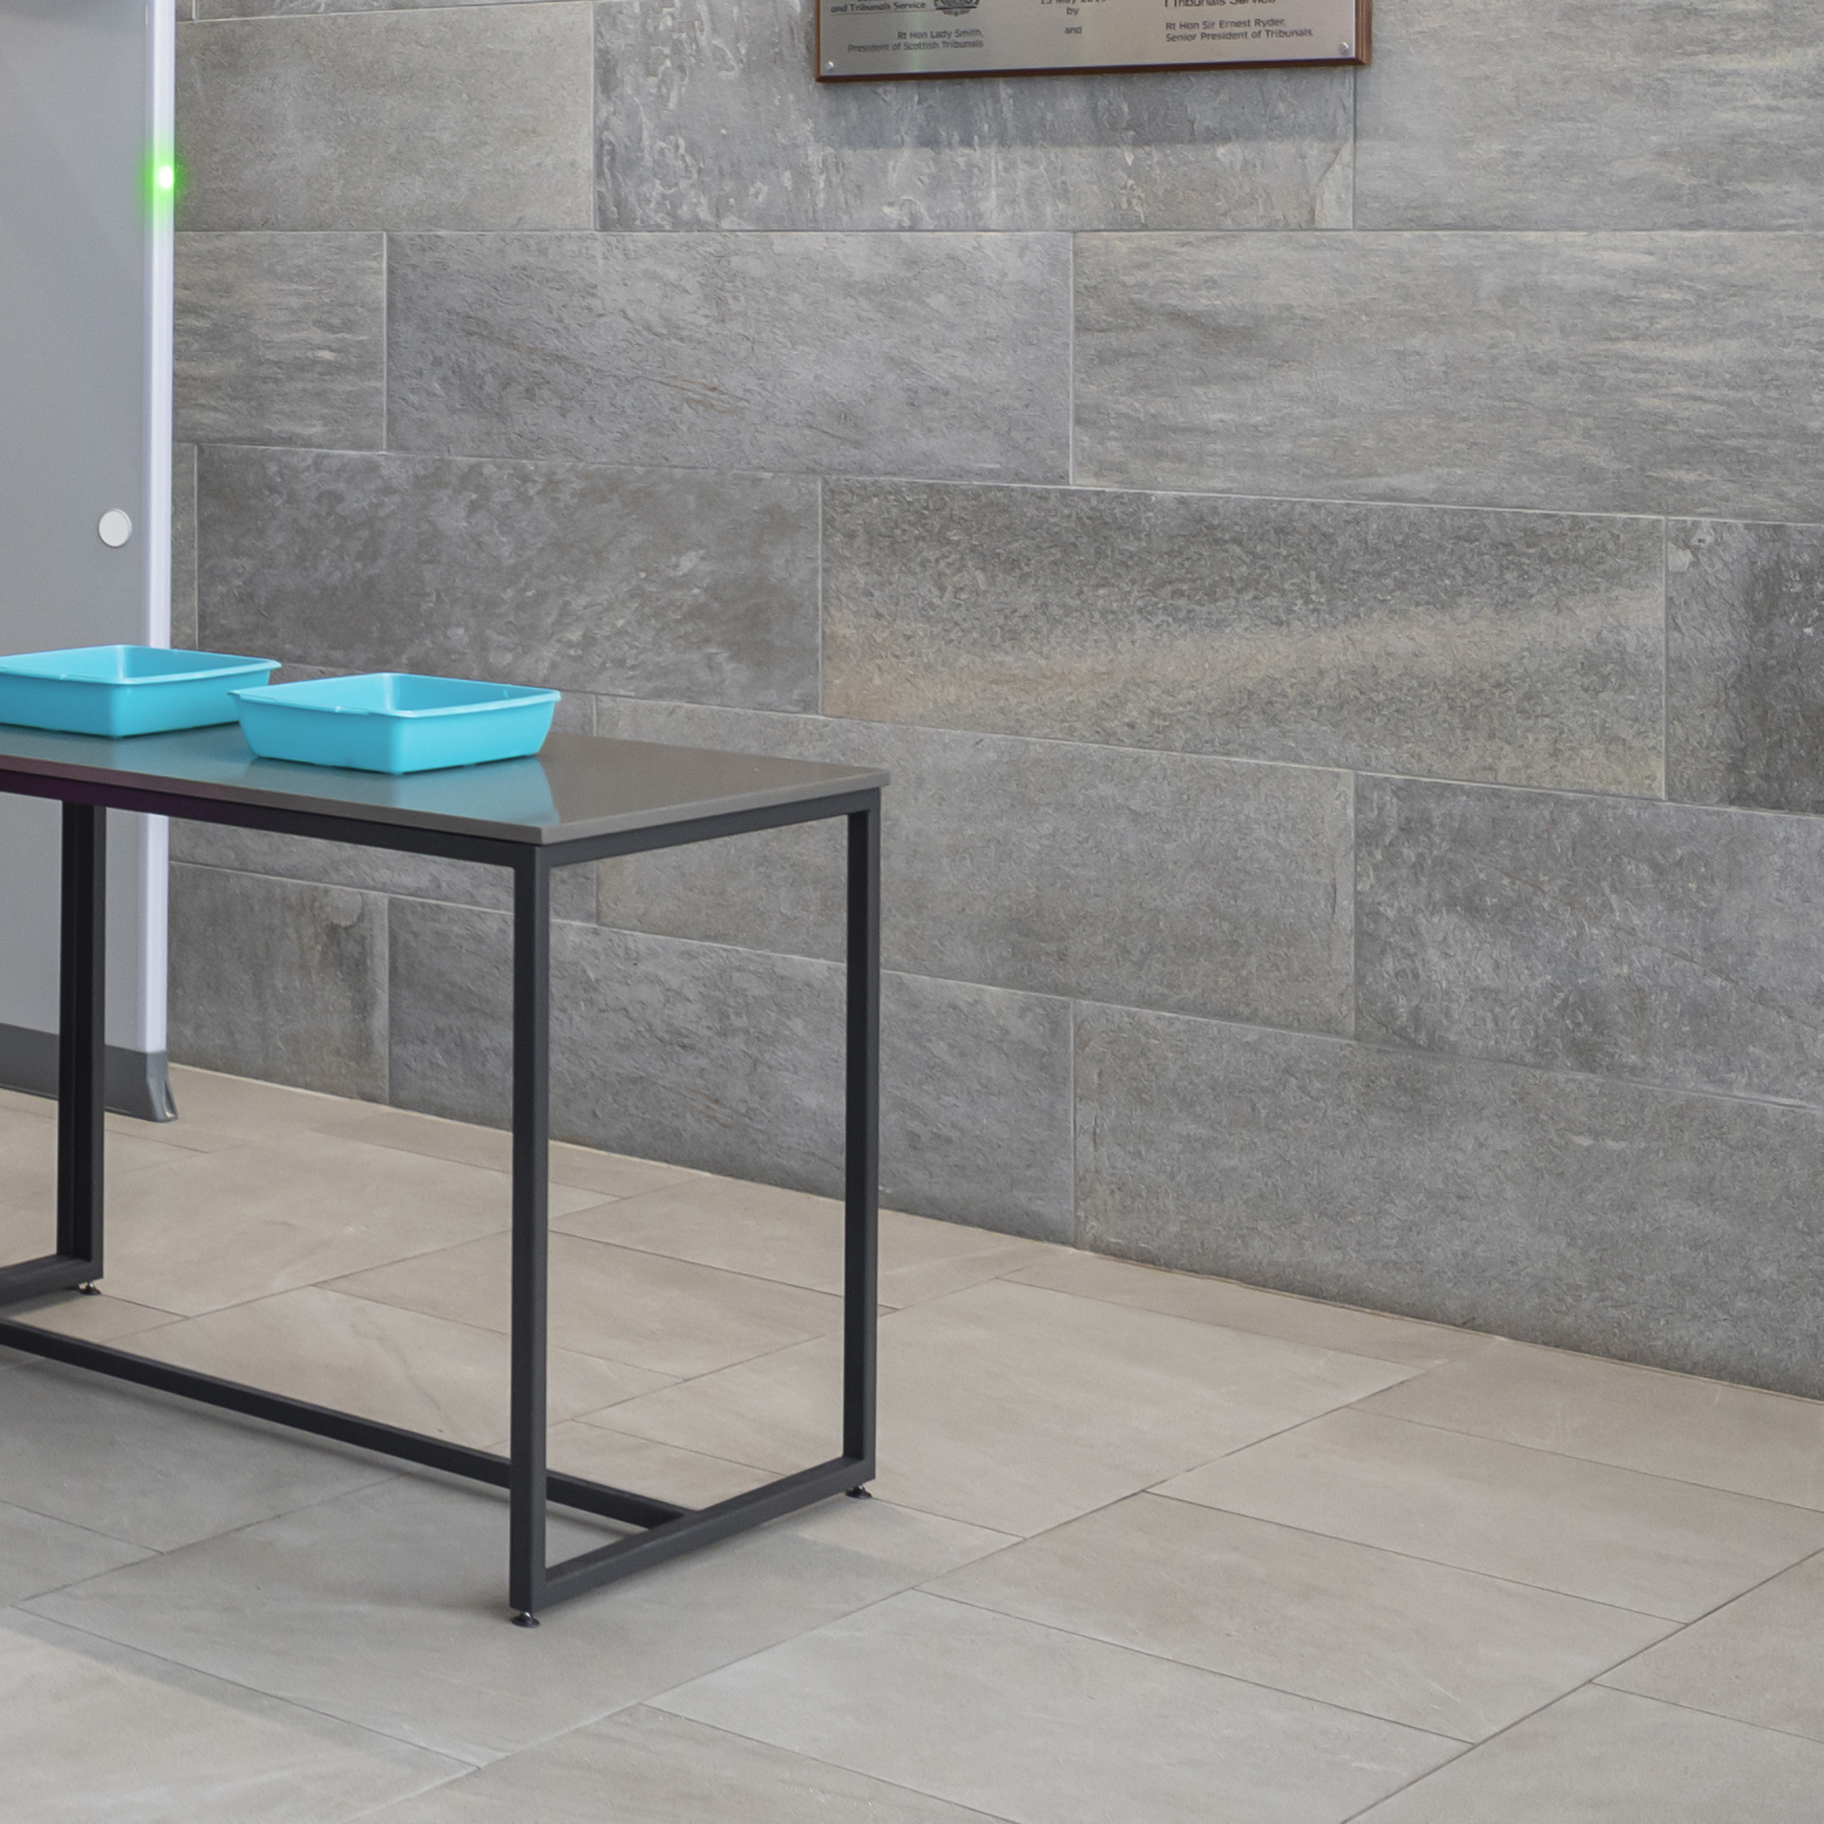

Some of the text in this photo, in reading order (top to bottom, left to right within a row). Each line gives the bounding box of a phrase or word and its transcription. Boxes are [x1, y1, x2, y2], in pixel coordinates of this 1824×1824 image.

[831, 0, 926, 13] and Tribunals Service
[1066, 6, 1080, 17] by
[1064, 26, 1082, 35] and
[1165, 21, 1176, 31] Rt
[1179, 21, 1200, 30] Hon
[1202, 20, 1215, 29] Sir
[1219, 18, 1251, 28] Ernest
[909, 30, 928, 39] Hon
[930, 29, 952, 40] Lady
[1165, 27, 1313, 43] Senior President of Tribunals
[848, 39, 984, 53] President of Scottish Tribunals
